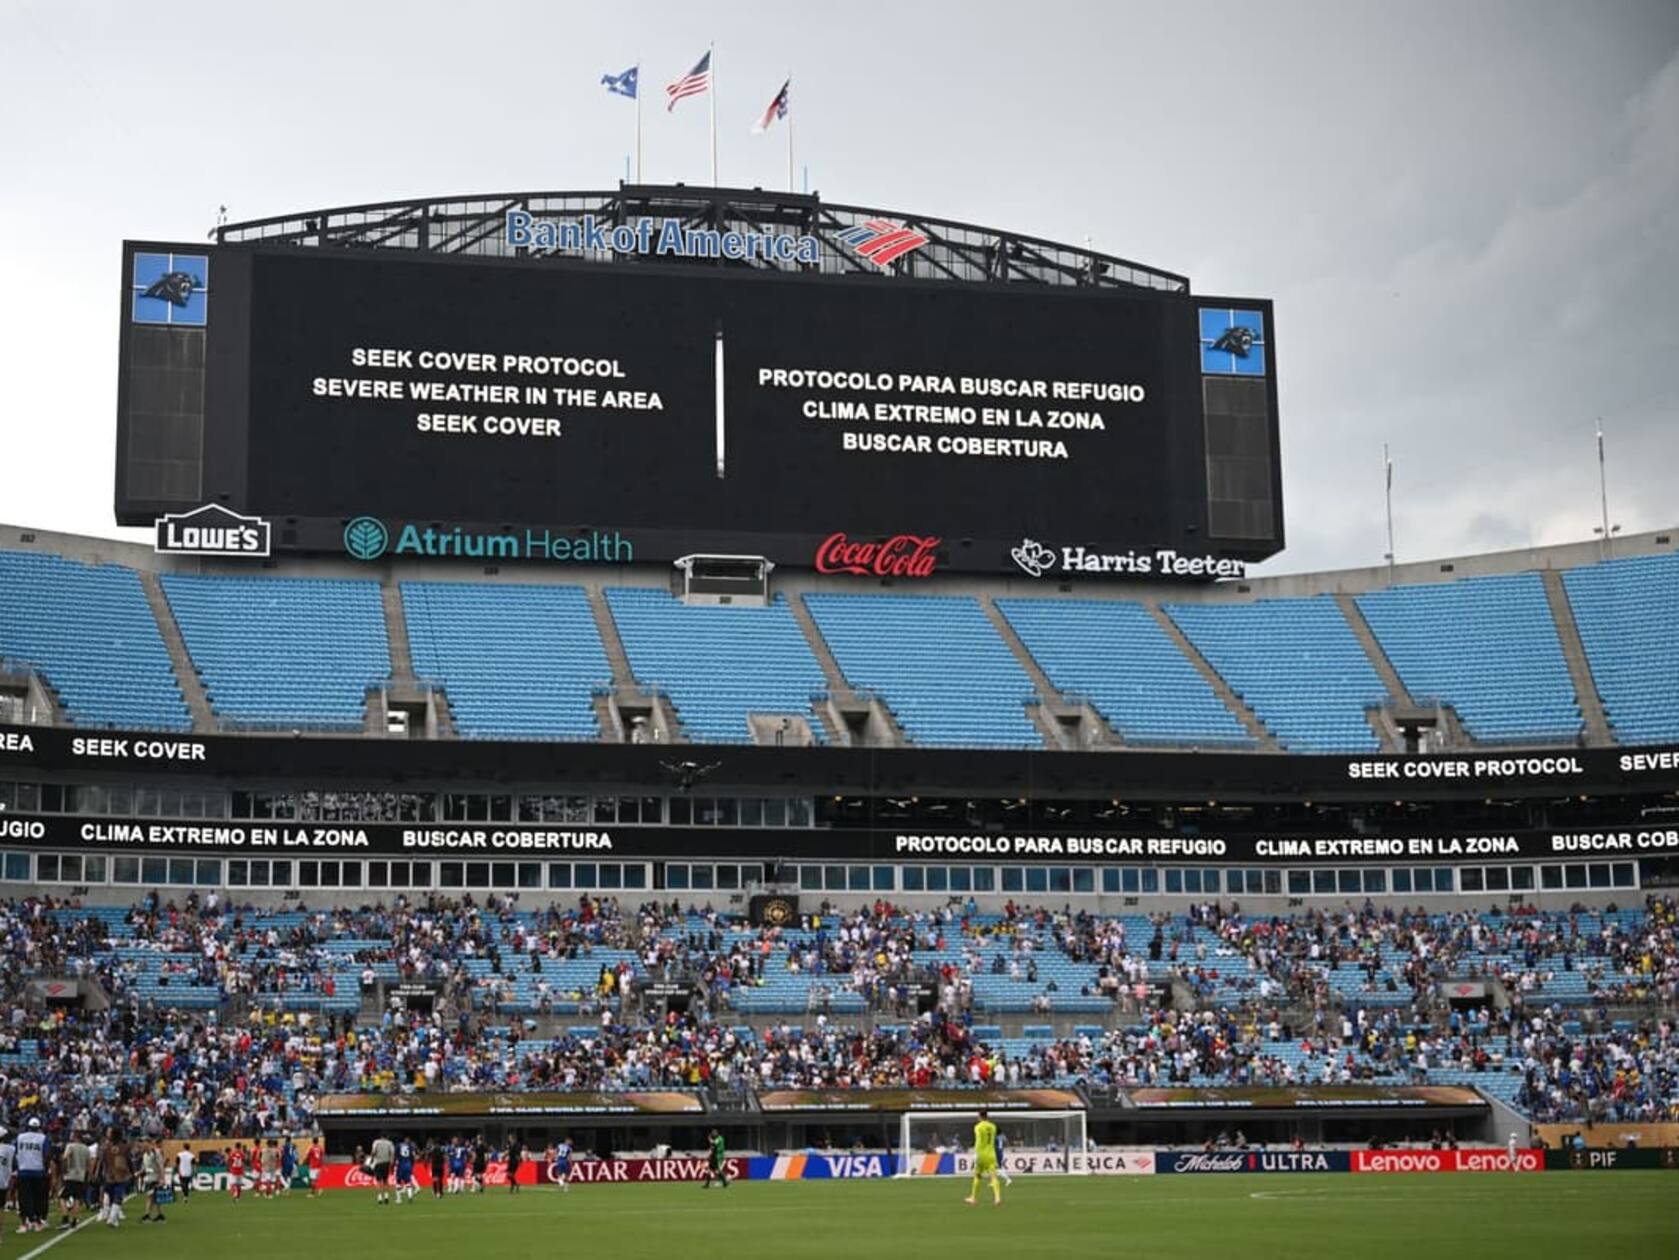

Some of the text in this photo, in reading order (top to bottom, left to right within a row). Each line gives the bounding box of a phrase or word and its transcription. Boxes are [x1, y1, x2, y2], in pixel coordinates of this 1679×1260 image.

[506, 209, 819, 263] Bank of America
[352, 348, 625, 377] SEEK COVER PROTOCOL
[313, 378, 663, 409] SEVERE WEATHER IN THE AREA
[759, 369, 1144, 402] PROTOCOLO PARA BUSCAR REFUGIO
[417, 414, 561, 436] SEEK COVER
[803, 401, 1105, 429] CLIMA EXTREMO EN LA ZONA
[843, 433, 1068, 458] BUSCAR COBERTURA
[167, 521, 258, 552] LOWE'S
[395, 525, 634, 561] Atrium Health
[1062, 547, 1246, 578] Harris Teeter
[73, 738, 205, 760] SEEK COVER
[1349, 758, 1583, 778] SEEK COVER PROTOCOL
[81, 824, 368, 845] CLIMA EXTREMO EN LA ZONA
[403, 831, 612, 848] BUSCAR COBERTURA
[896, 836, 1226, 855] PROTOCOLO PARA BUSCAR REFUGIO
[1552, 834, 1632, 850] BUSCAR
[1256, 837, 1519, 855] CLIMA EXTREMO EN LA ZONA
[825, 1156, 883, 1178] VISA
[1175, 1154, 1328, 1172] Michelob ULTRA
[1359, 1152, 1440, 1171] Lenovo
[1589, 1151, 1617, 1167] PIF
